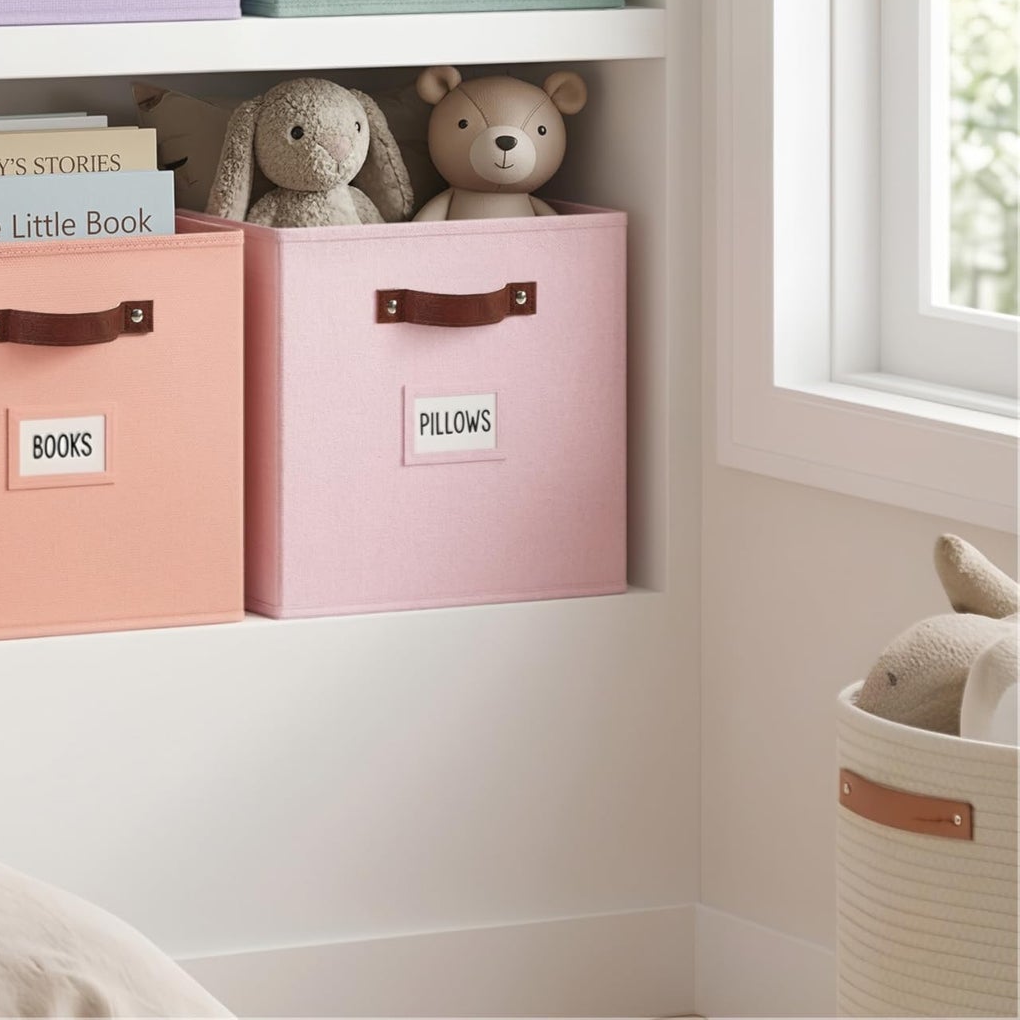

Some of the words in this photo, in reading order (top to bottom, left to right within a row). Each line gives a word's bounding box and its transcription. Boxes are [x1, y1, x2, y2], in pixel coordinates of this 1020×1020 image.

[33, 153, 122, 175] STORIES
[12, 211, 76, 239] Little
[87, 207, 153, 235] Book
[420, 409, 491, 436] PILLOWS
[33, 432, 92, 459] BOOKS
